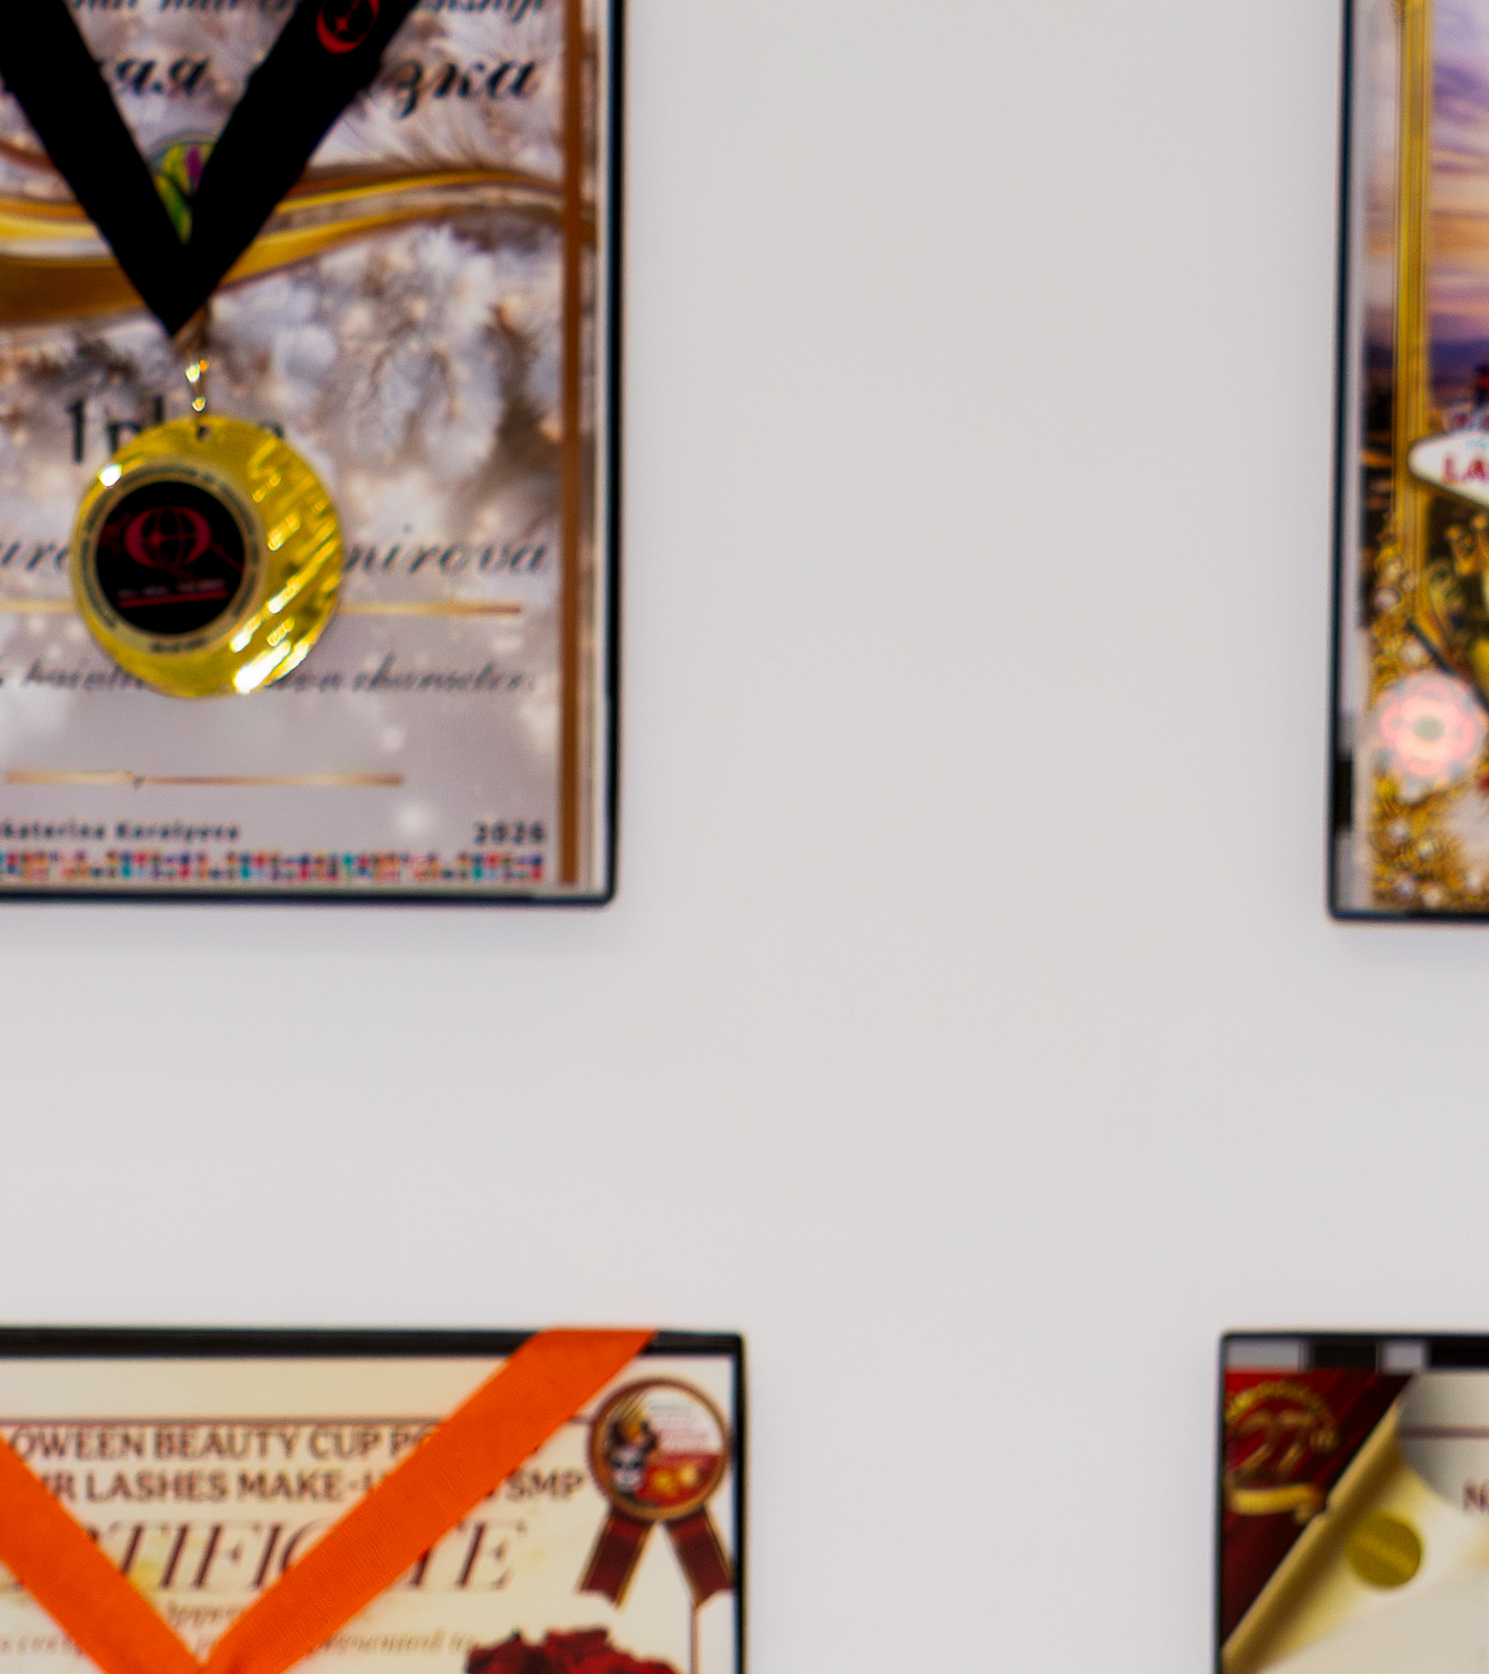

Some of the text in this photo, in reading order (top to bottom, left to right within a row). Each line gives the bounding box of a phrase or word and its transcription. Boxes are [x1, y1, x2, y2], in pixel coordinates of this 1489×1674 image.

[153, 1430, 296, 1461] BEAUTY
[310, 1431, 383, 1461] CUP
[86, 1470, 226, 1503] LASHES
